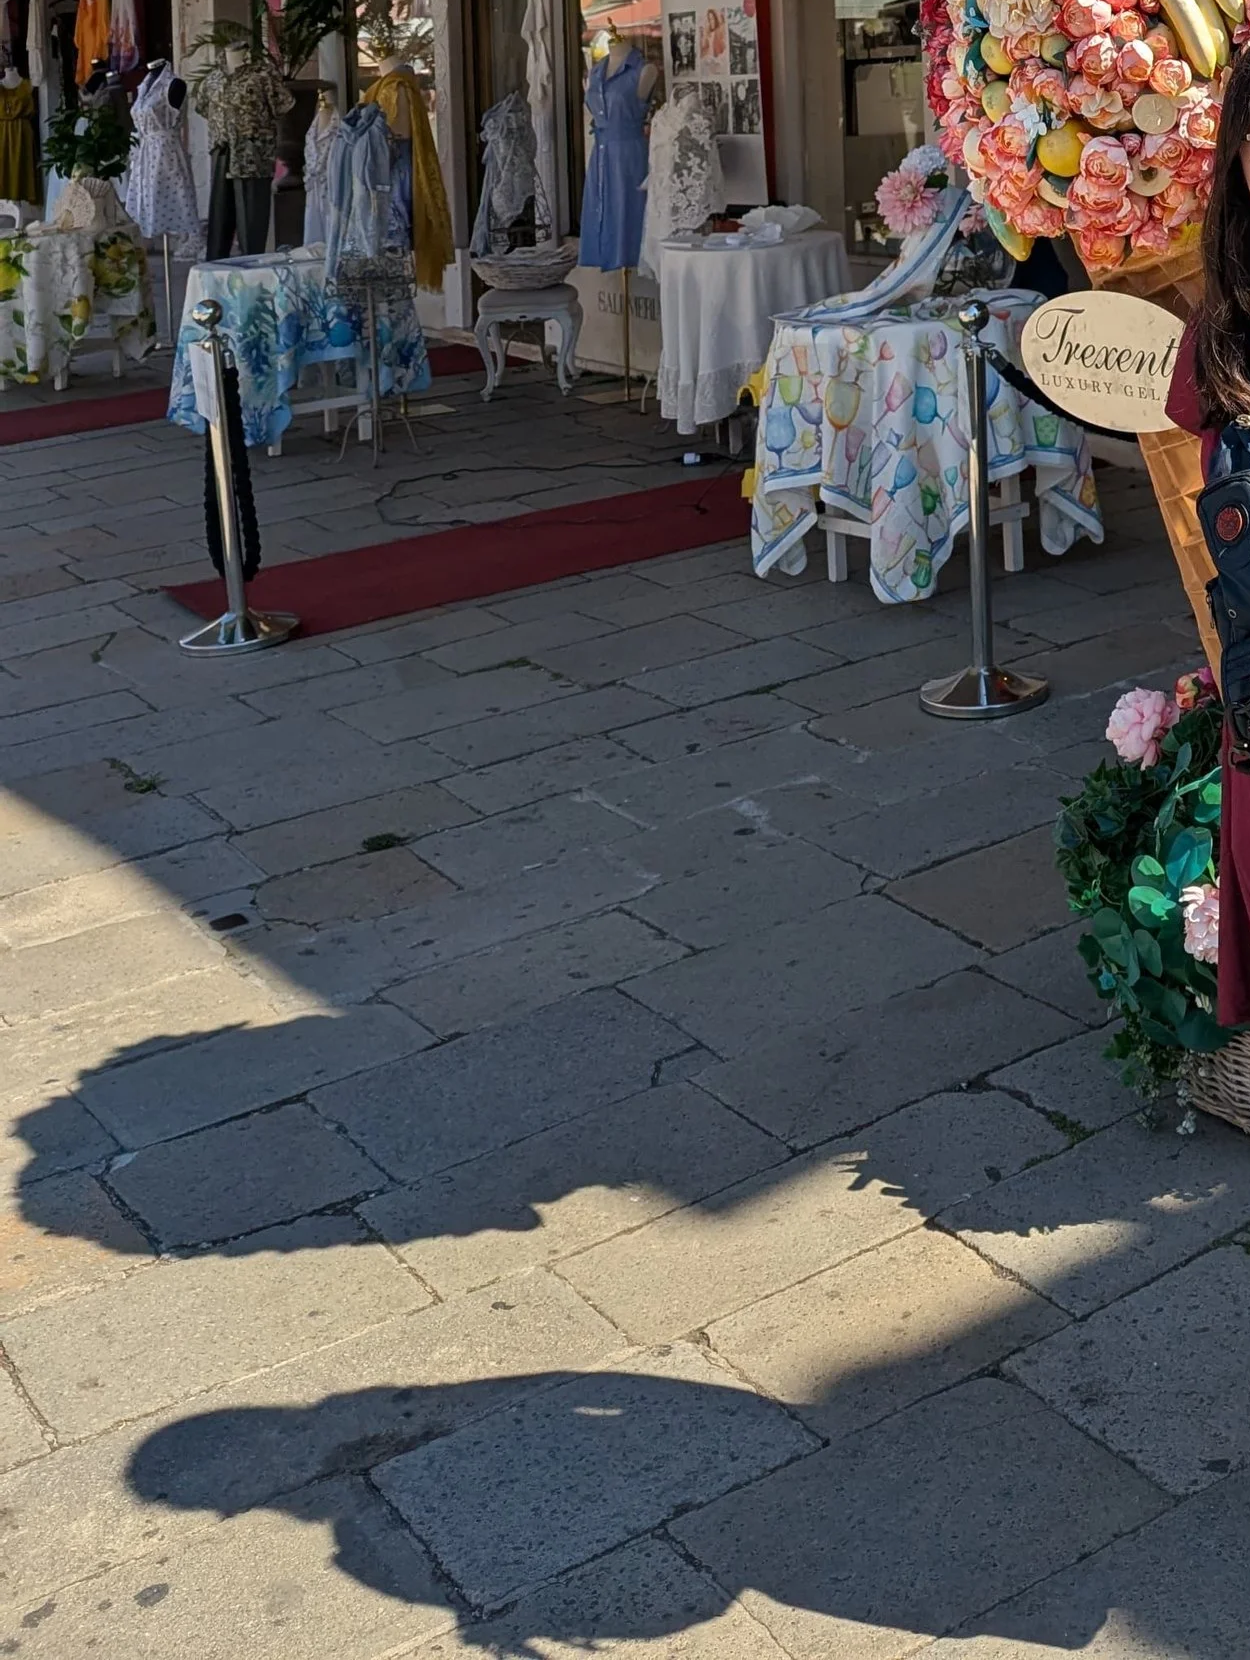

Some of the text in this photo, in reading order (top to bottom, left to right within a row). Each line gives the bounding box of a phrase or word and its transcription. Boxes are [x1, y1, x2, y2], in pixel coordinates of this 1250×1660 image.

[1035, 307, 1179, 379] Trexent
[1041, 373, 1169, 402] LUXURY GEL
